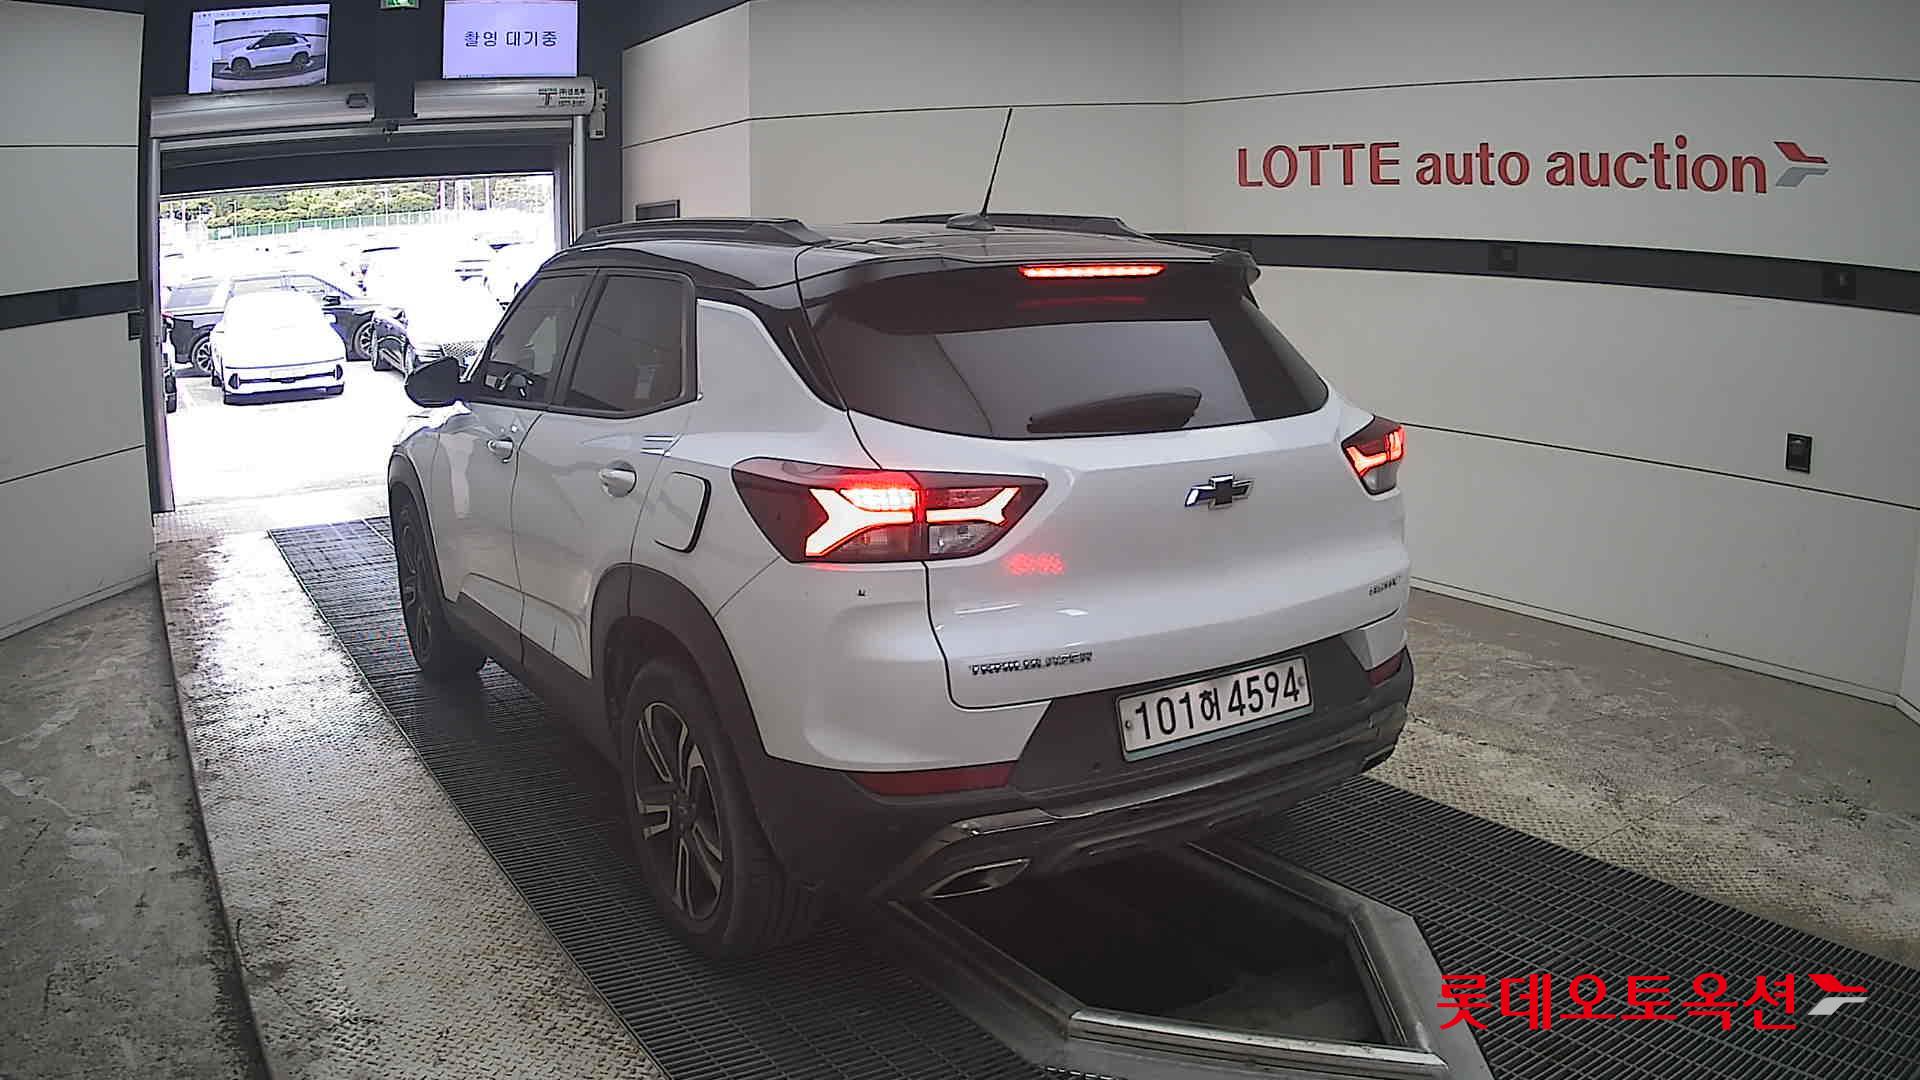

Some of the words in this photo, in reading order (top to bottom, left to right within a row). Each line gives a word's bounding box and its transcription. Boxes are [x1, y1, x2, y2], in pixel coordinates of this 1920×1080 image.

[465, 31, 497, 47] 촬영
[505, 31, 557, 47] 대기중
[1238, 142, 1399, 188] LOTTE
[1415, 142, 1531, 186] auto
[1545, 134, 1767, 194] auction
